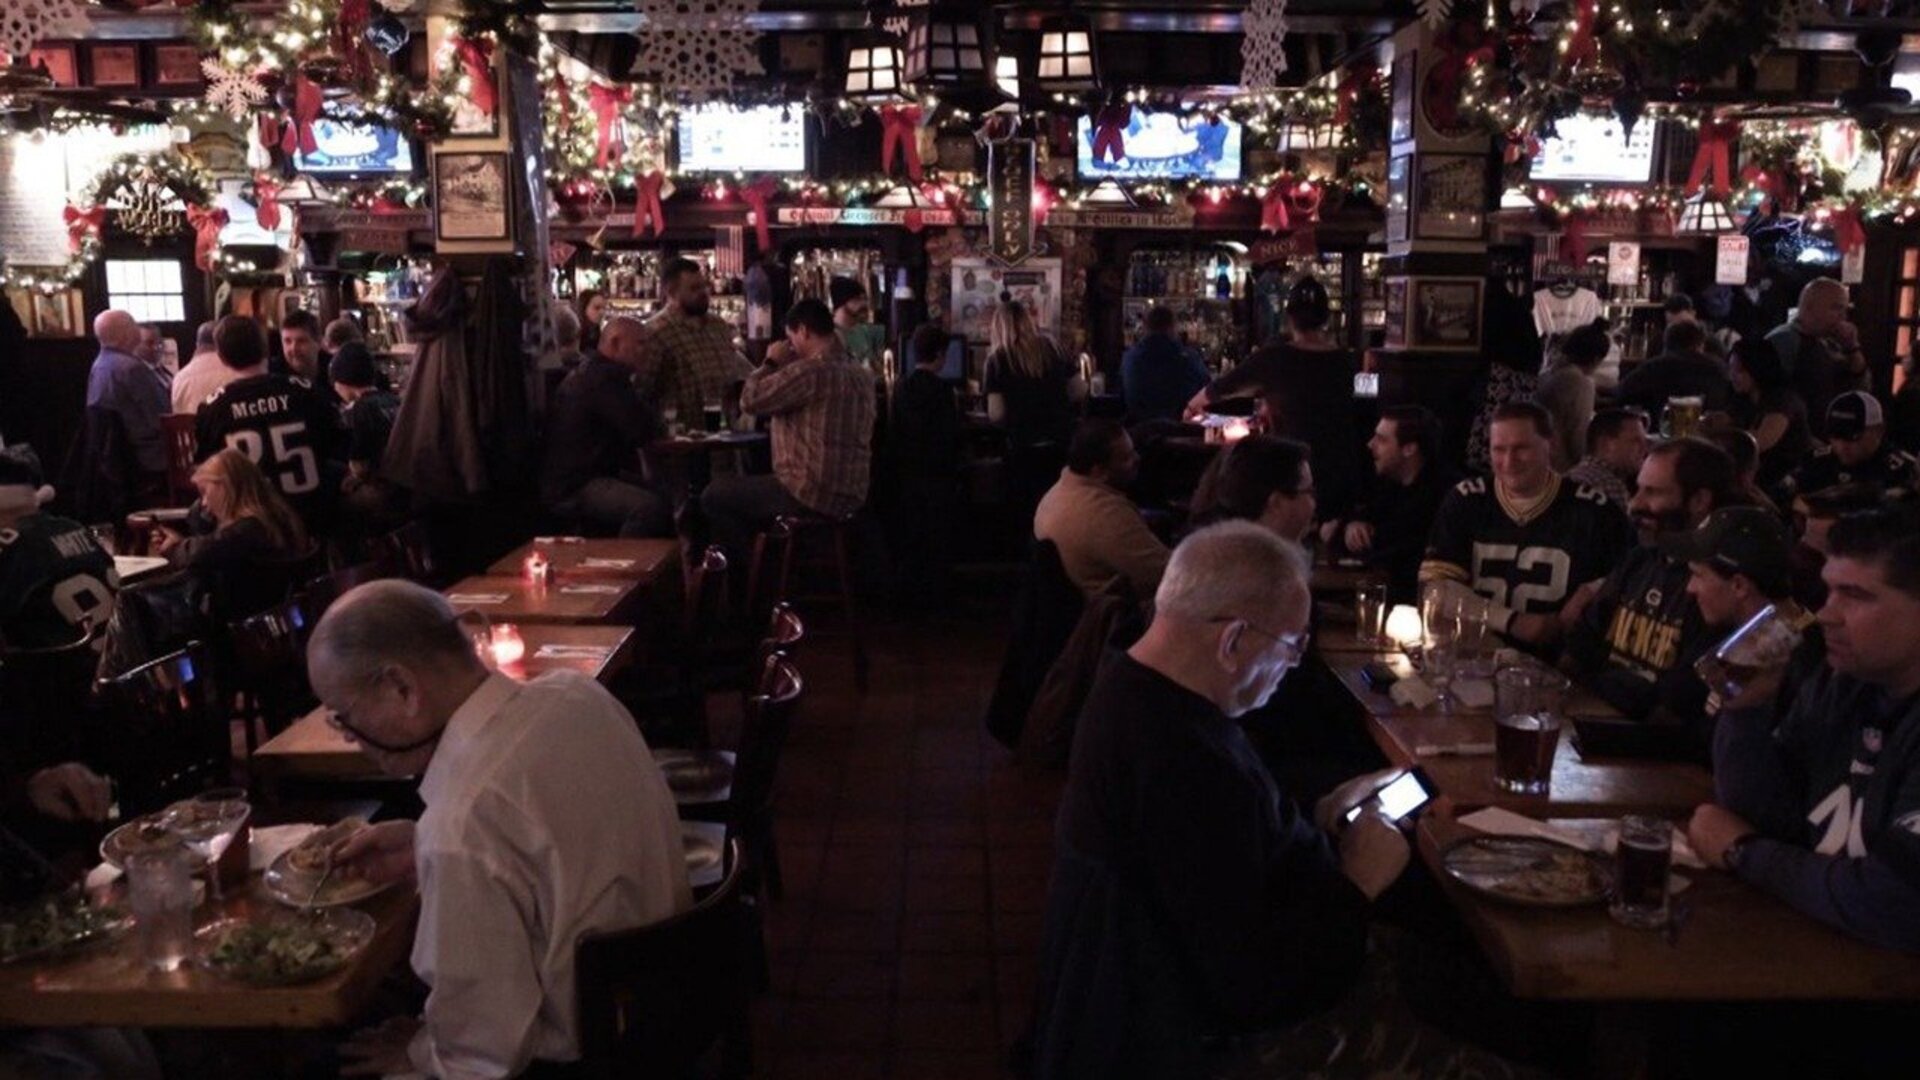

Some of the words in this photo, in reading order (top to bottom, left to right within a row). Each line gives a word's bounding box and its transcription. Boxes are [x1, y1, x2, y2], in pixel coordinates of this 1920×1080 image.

[1002, 209, 1021, 256] ONLY
[231, 394, 289, 420] McCOY
[1471, 540, 1572, 614] 52
